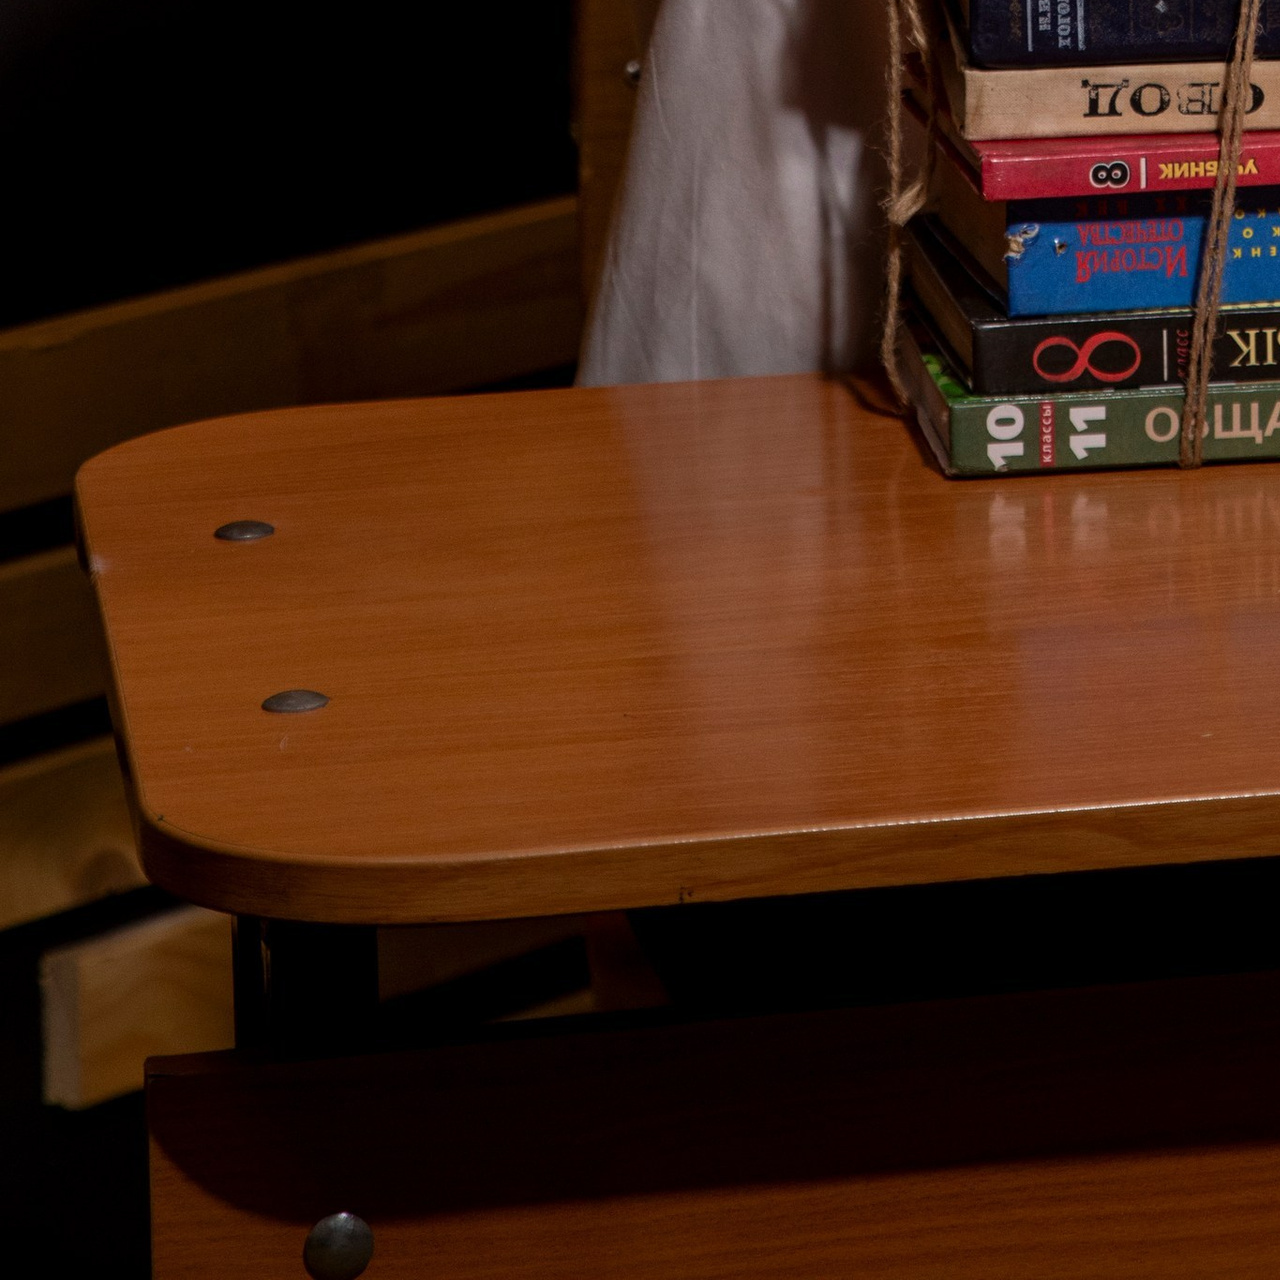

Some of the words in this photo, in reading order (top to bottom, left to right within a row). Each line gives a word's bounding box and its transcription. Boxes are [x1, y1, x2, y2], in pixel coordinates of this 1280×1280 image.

[1089, 159, 1131, 188] 8
[1076, 218, 1184, 247] ОТЕЧЕСТВА
[1032, 329, 1142, 383] 8
[985, 402, 1024, 471] 10
[1041, 403, 1054, 464] классы
[1069, 404, 1106, 460] 11
